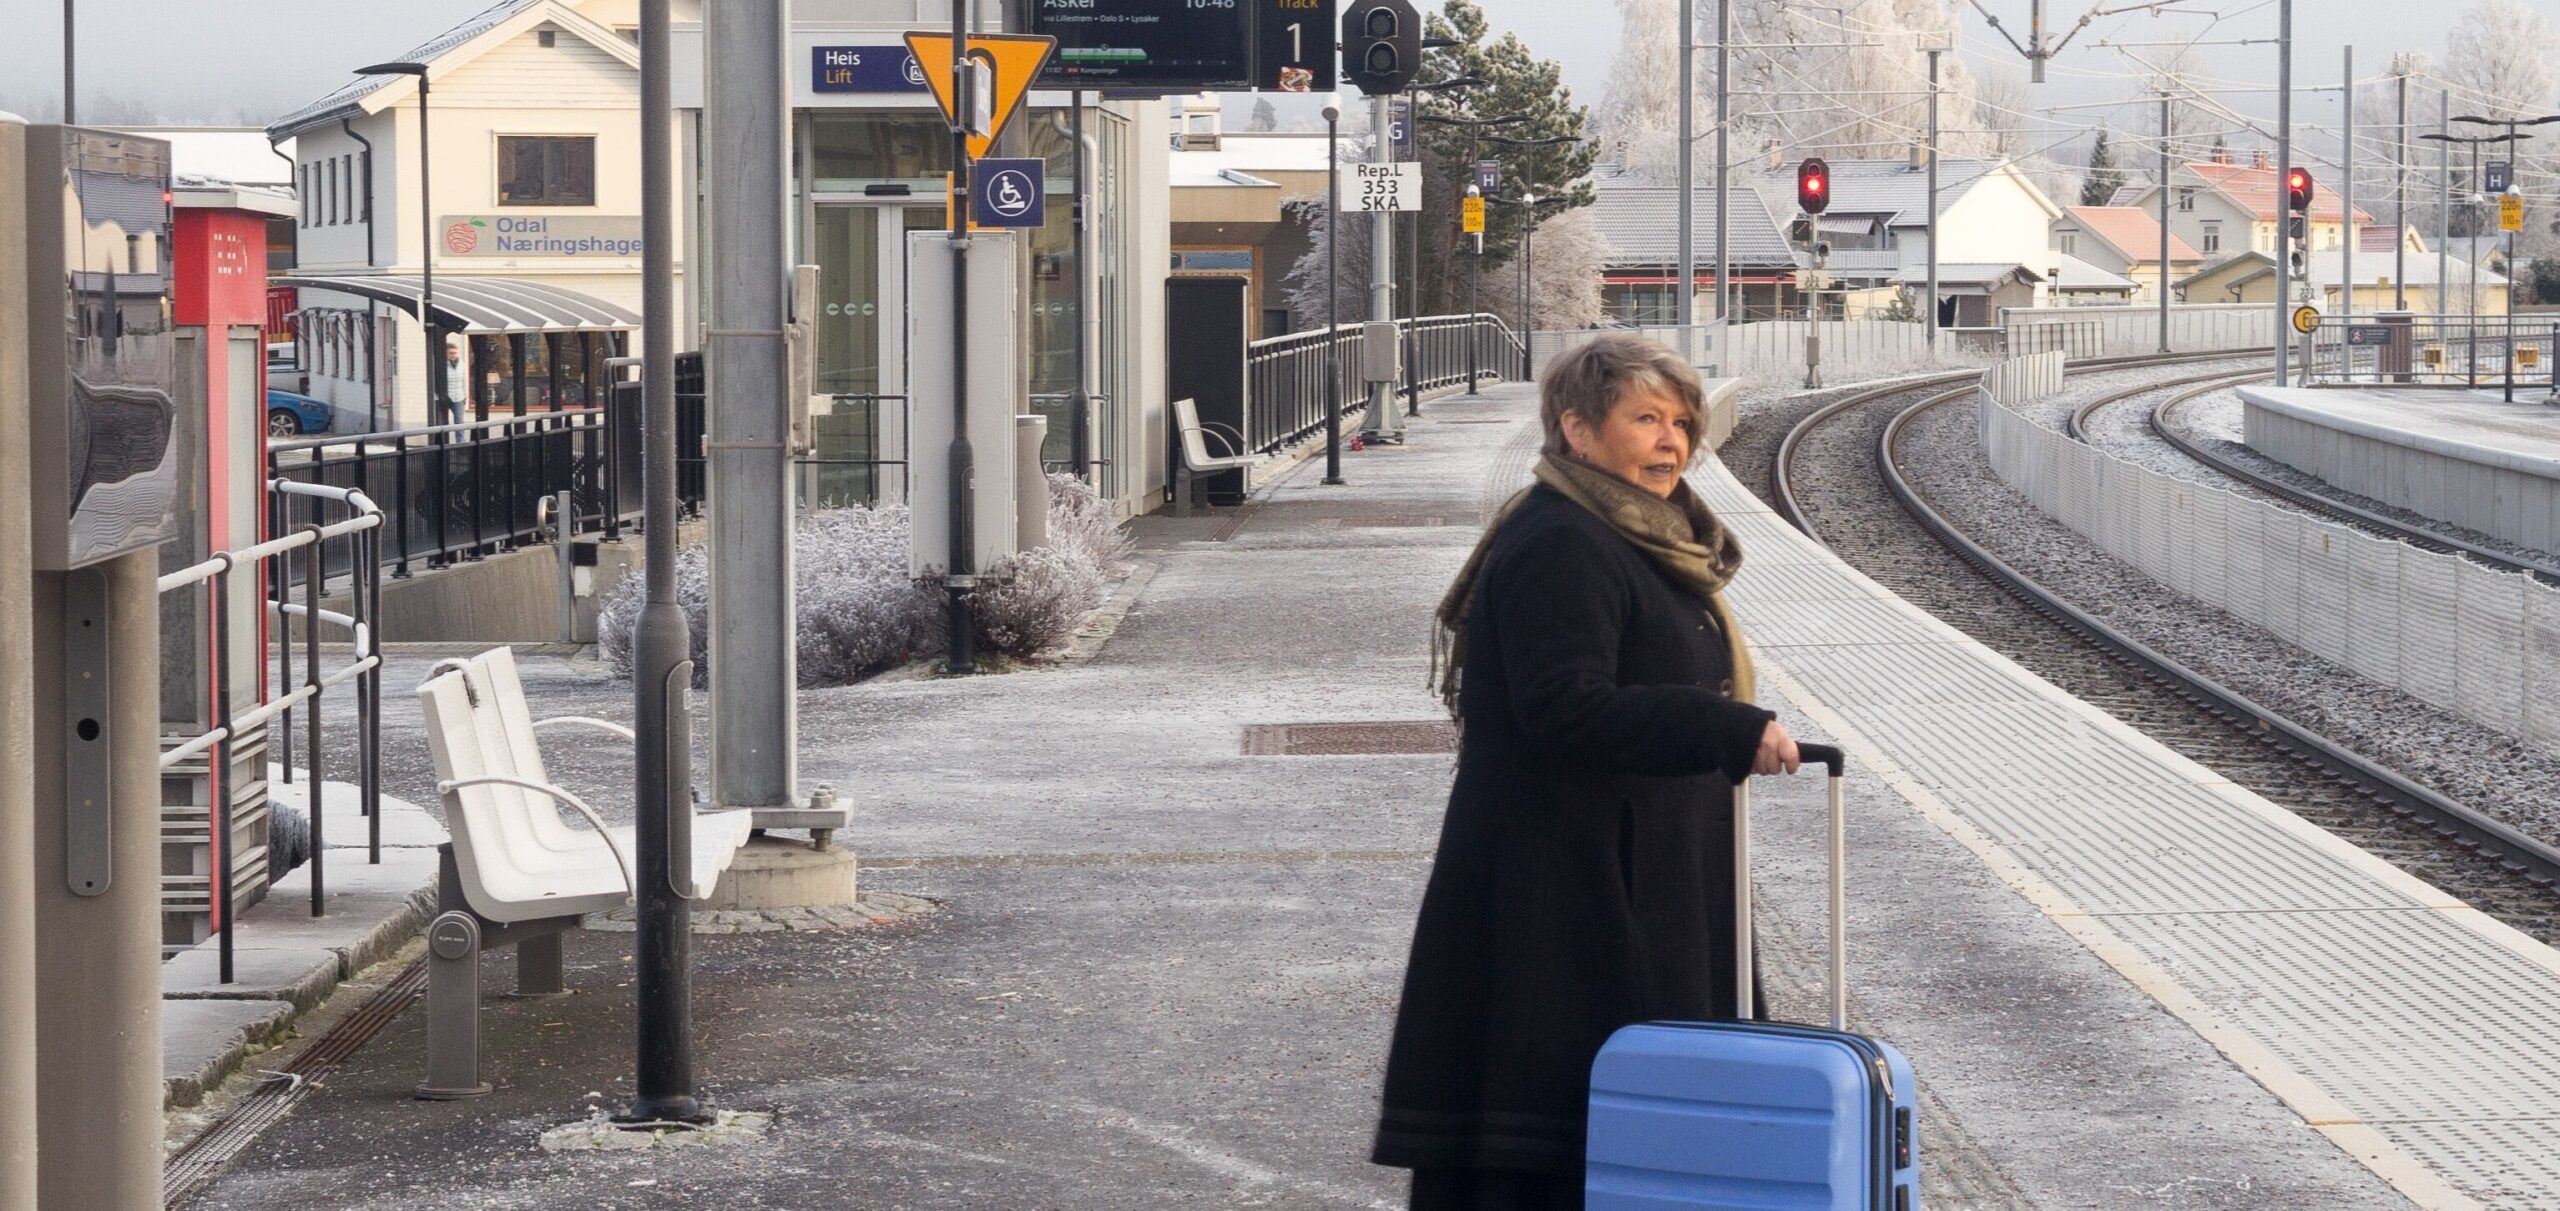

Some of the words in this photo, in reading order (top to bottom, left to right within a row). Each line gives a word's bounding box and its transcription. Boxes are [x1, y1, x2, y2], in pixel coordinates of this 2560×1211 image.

[1100, 14, 1118, 22] Oslo
[1119, 14, 1125, 22] S
[1286, 22, 1301, 63] 1
[825, 51, 861, 66] Heis
[825, 69, 853, 84] Lift
[1388, 121, 1403, 140] G
[1357, 163, 1404, 180] Rep.L
[1363, 180, 1399, 195] 353
[1482, 174, 1495, 187] H
[2489, 174, 2502, 188] H
[1361, 195, 1401, 211] SKA
[496, 217, 548, 233] Odal
